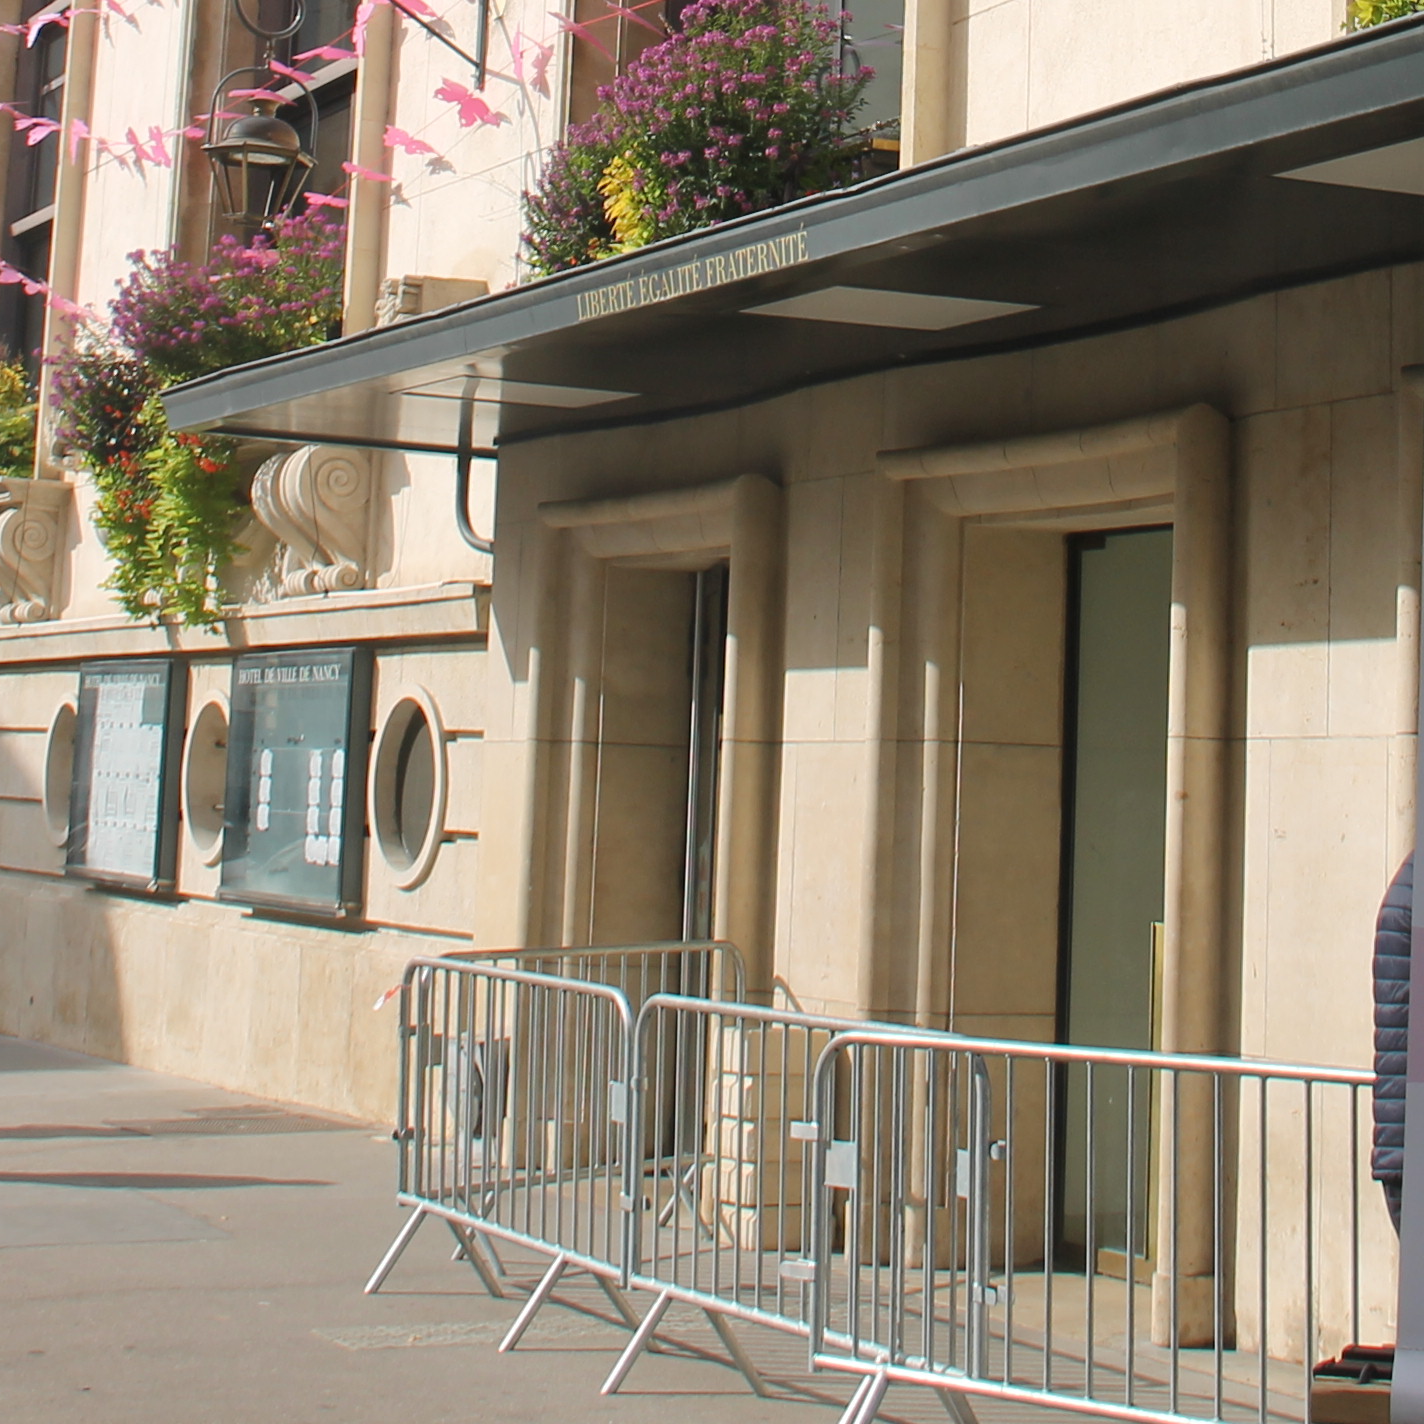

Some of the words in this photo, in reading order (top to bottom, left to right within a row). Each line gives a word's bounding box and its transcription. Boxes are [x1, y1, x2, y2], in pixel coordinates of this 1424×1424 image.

[577, 273, 636, 321] LIBERTÉ
[639, 254, 702, 304] ÉGALITÉ
[705, 222, 809, 287] FRATERNITÉ
[238, 669, 262, 684] HOTEL
[264, 668, 275, 683] DE
[277, 667, 297, 682] VILLE
[299, 666, 311, 682] DE
[312, 663, 341, 681] NANCY
